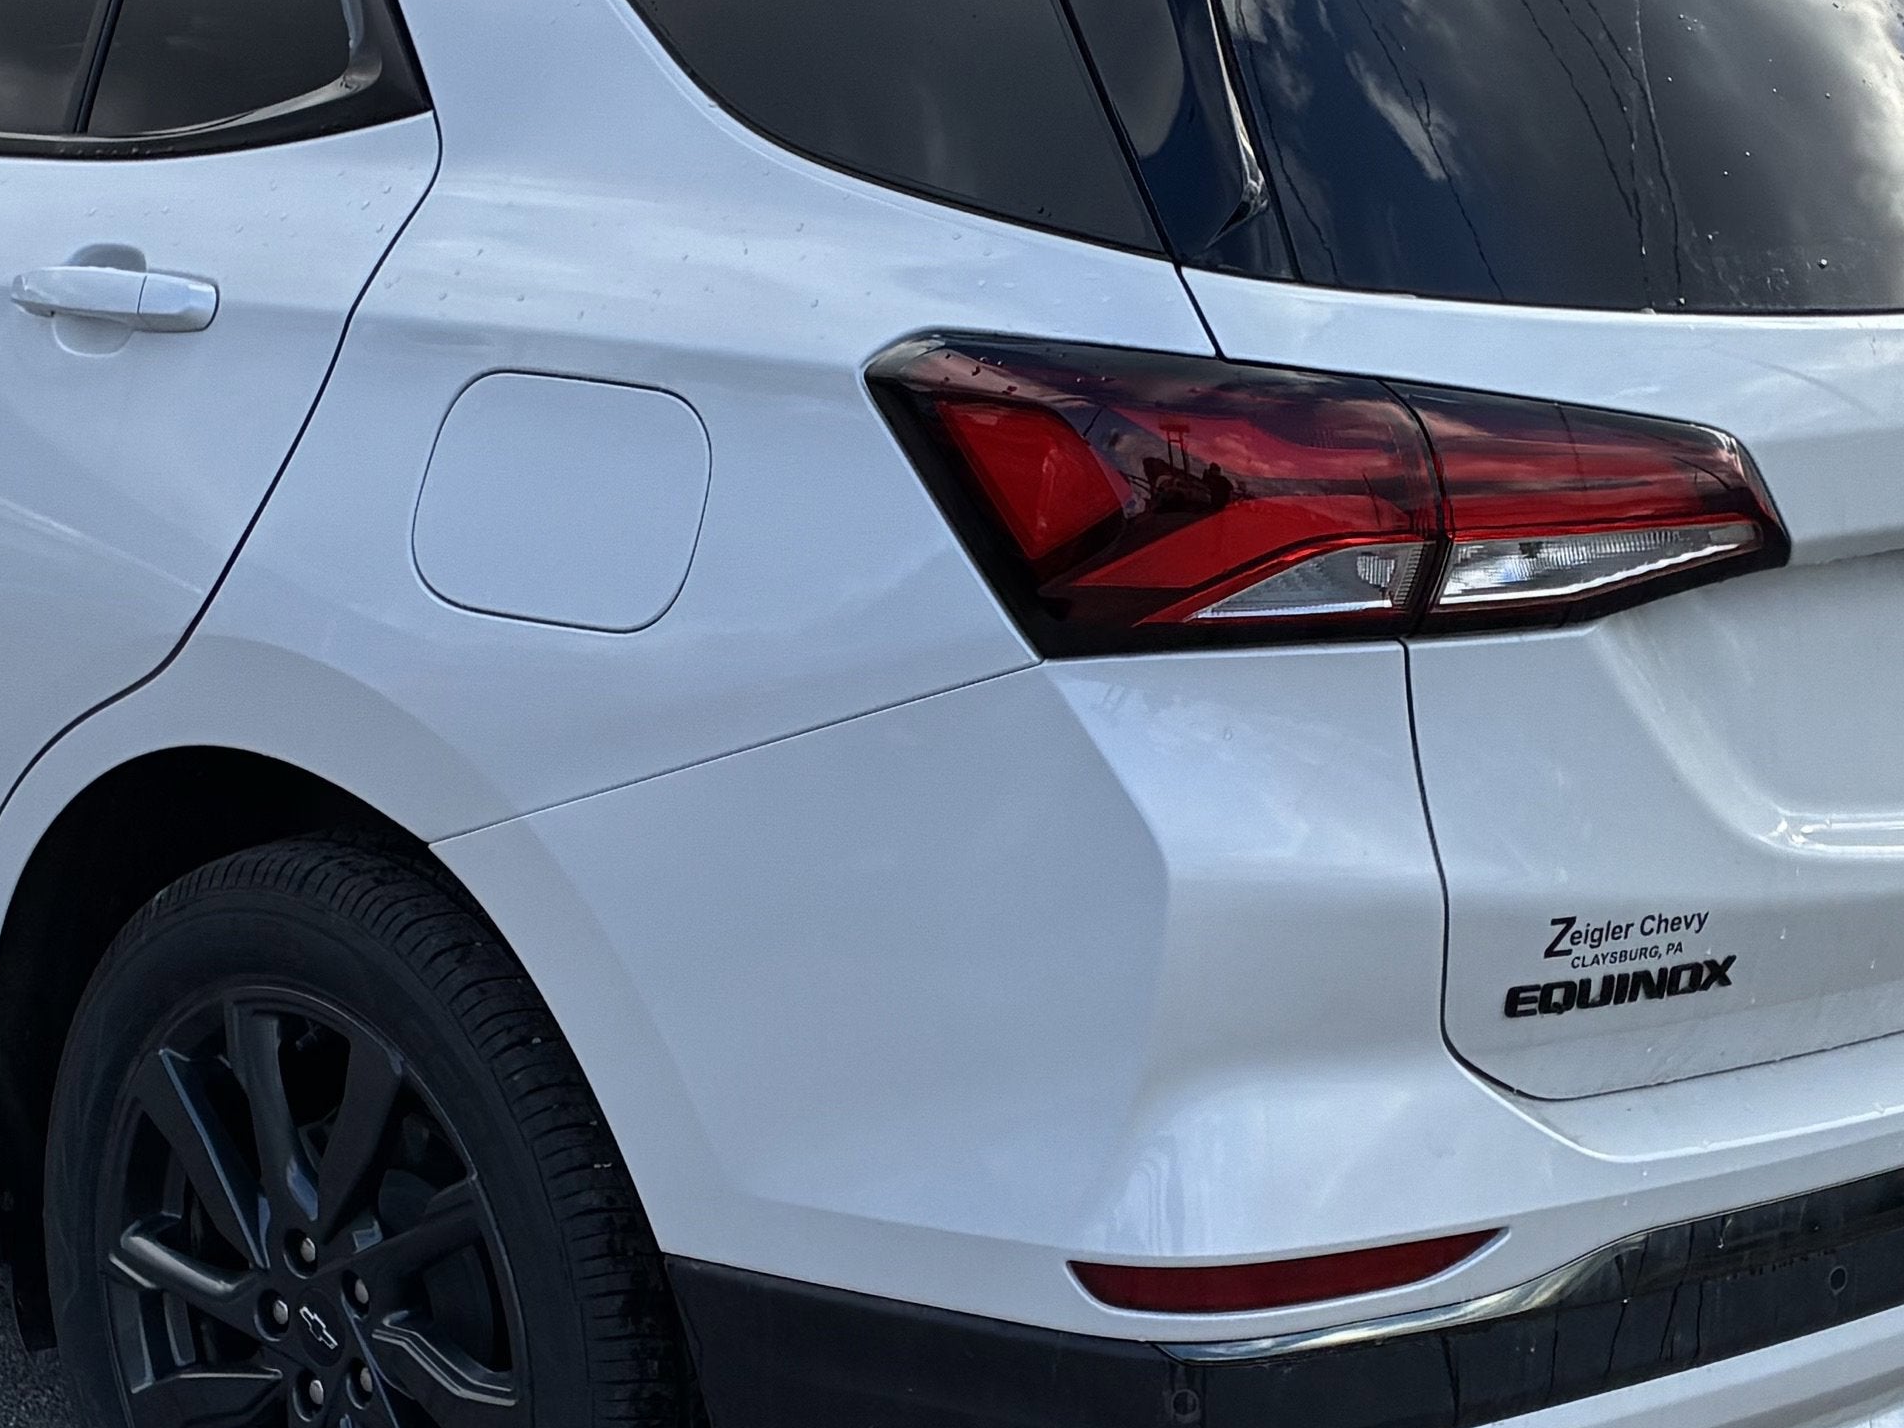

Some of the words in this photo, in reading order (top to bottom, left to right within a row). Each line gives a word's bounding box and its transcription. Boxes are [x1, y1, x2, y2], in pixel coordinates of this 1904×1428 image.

[1543, 916, 1634, 959] Zeigler
[1640, 911, 1709, 935] Chevy
[1571, 945, 1662, 968] CLAYSBURG,
[1666, 941, 1683, 954] PA
[1504, 955, 1737, 1018] EQUINOX
